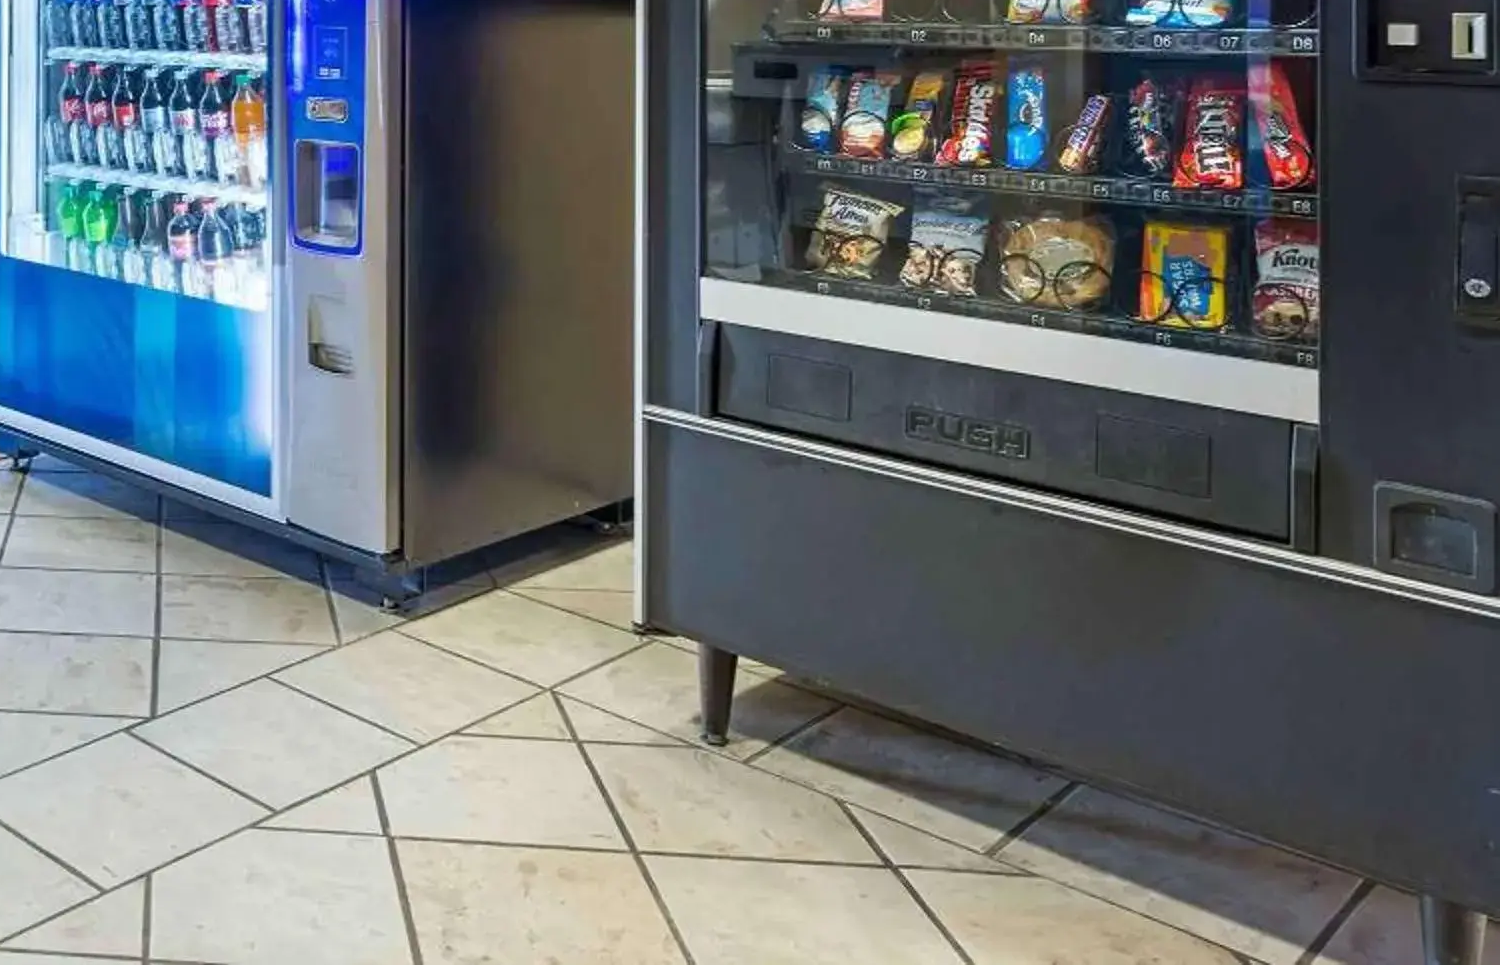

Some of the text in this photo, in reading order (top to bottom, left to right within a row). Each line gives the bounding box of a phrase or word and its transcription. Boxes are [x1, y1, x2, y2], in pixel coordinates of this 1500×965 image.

[1153, 34, 1172, 48] D6
[1221, 35, 1240, 49] D7
[1293, 37, 1313, 51] D8
[913, 167, 928, 180] E2
[972, 173, 988, 186] E3
[1153, 188, 1172, 203] E6
[1156, 333, 1172, 346] F6
[1298, 352, 1314, 365] F8
[906, 408, 1031, 459] PUSH
